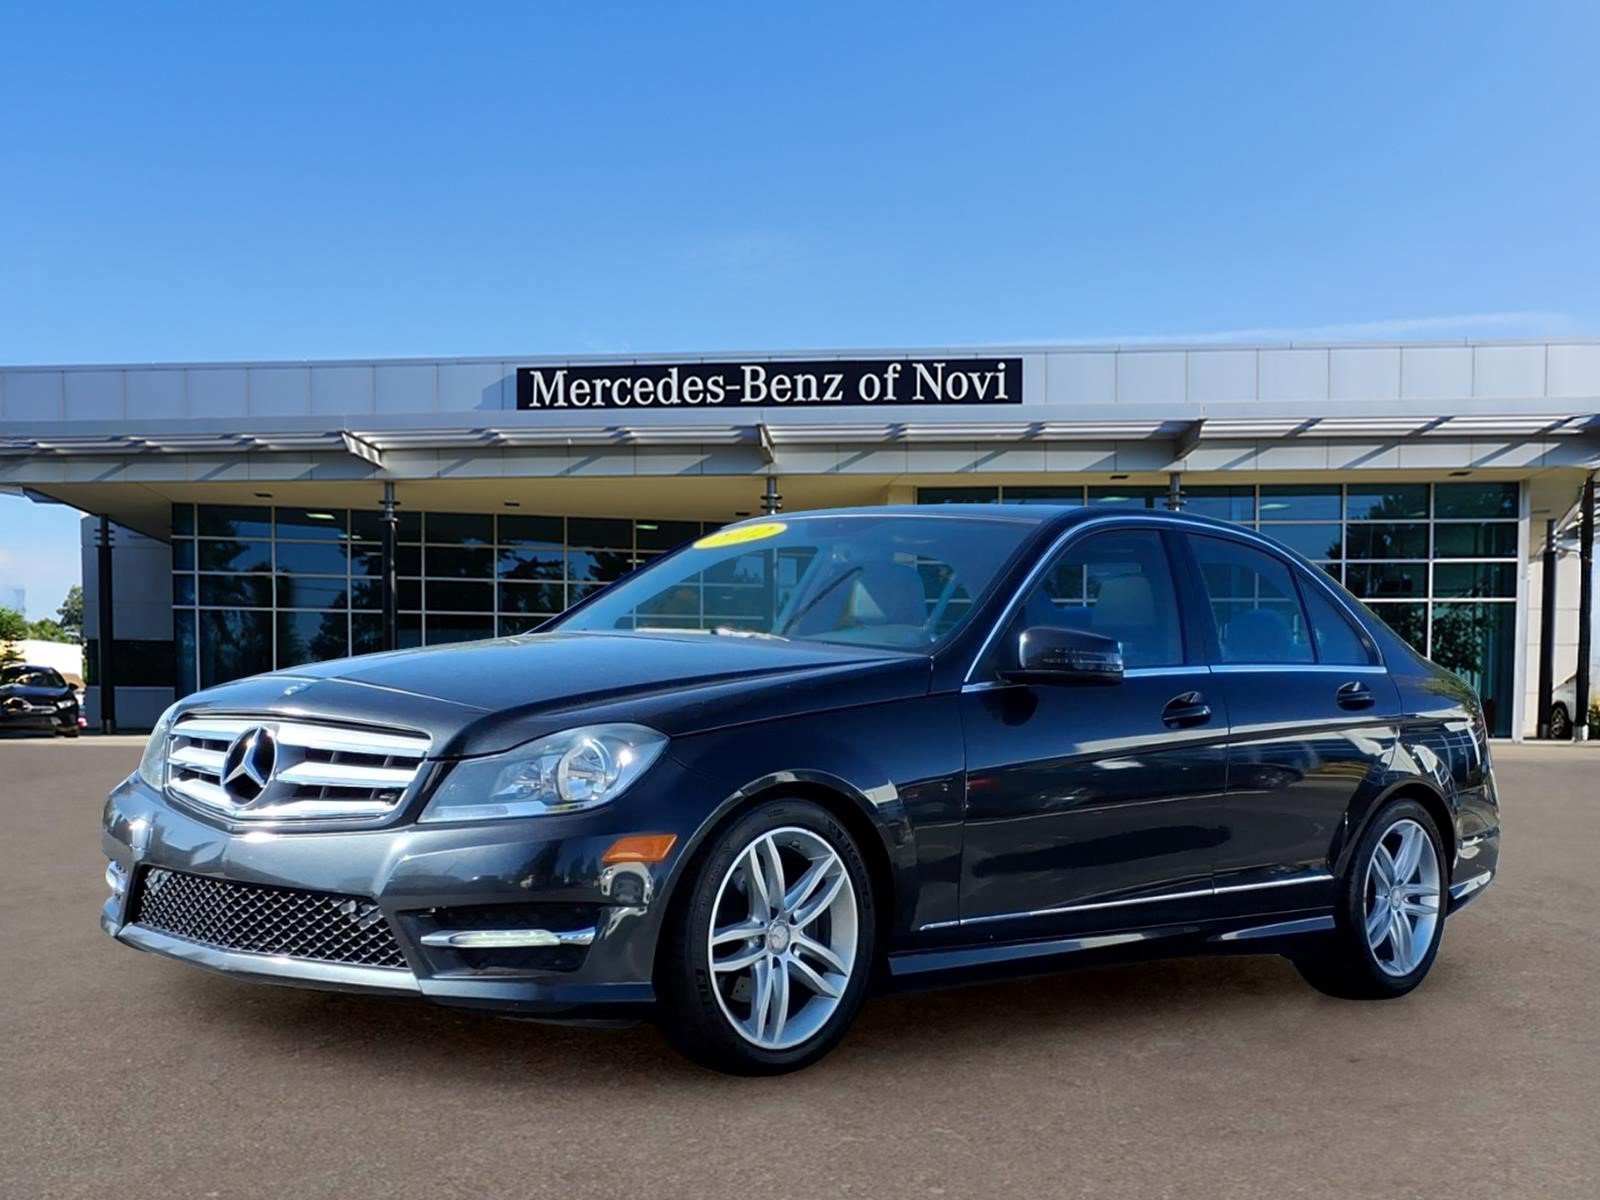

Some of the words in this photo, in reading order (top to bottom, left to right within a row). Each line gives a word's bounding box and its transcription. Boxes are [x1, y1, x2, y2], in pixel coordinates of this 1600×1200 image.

[529, 365, 844, 407] Mercedes-Benz
[858, 363, 901, 401] of
[912, 362, 1009, 400] Novi
